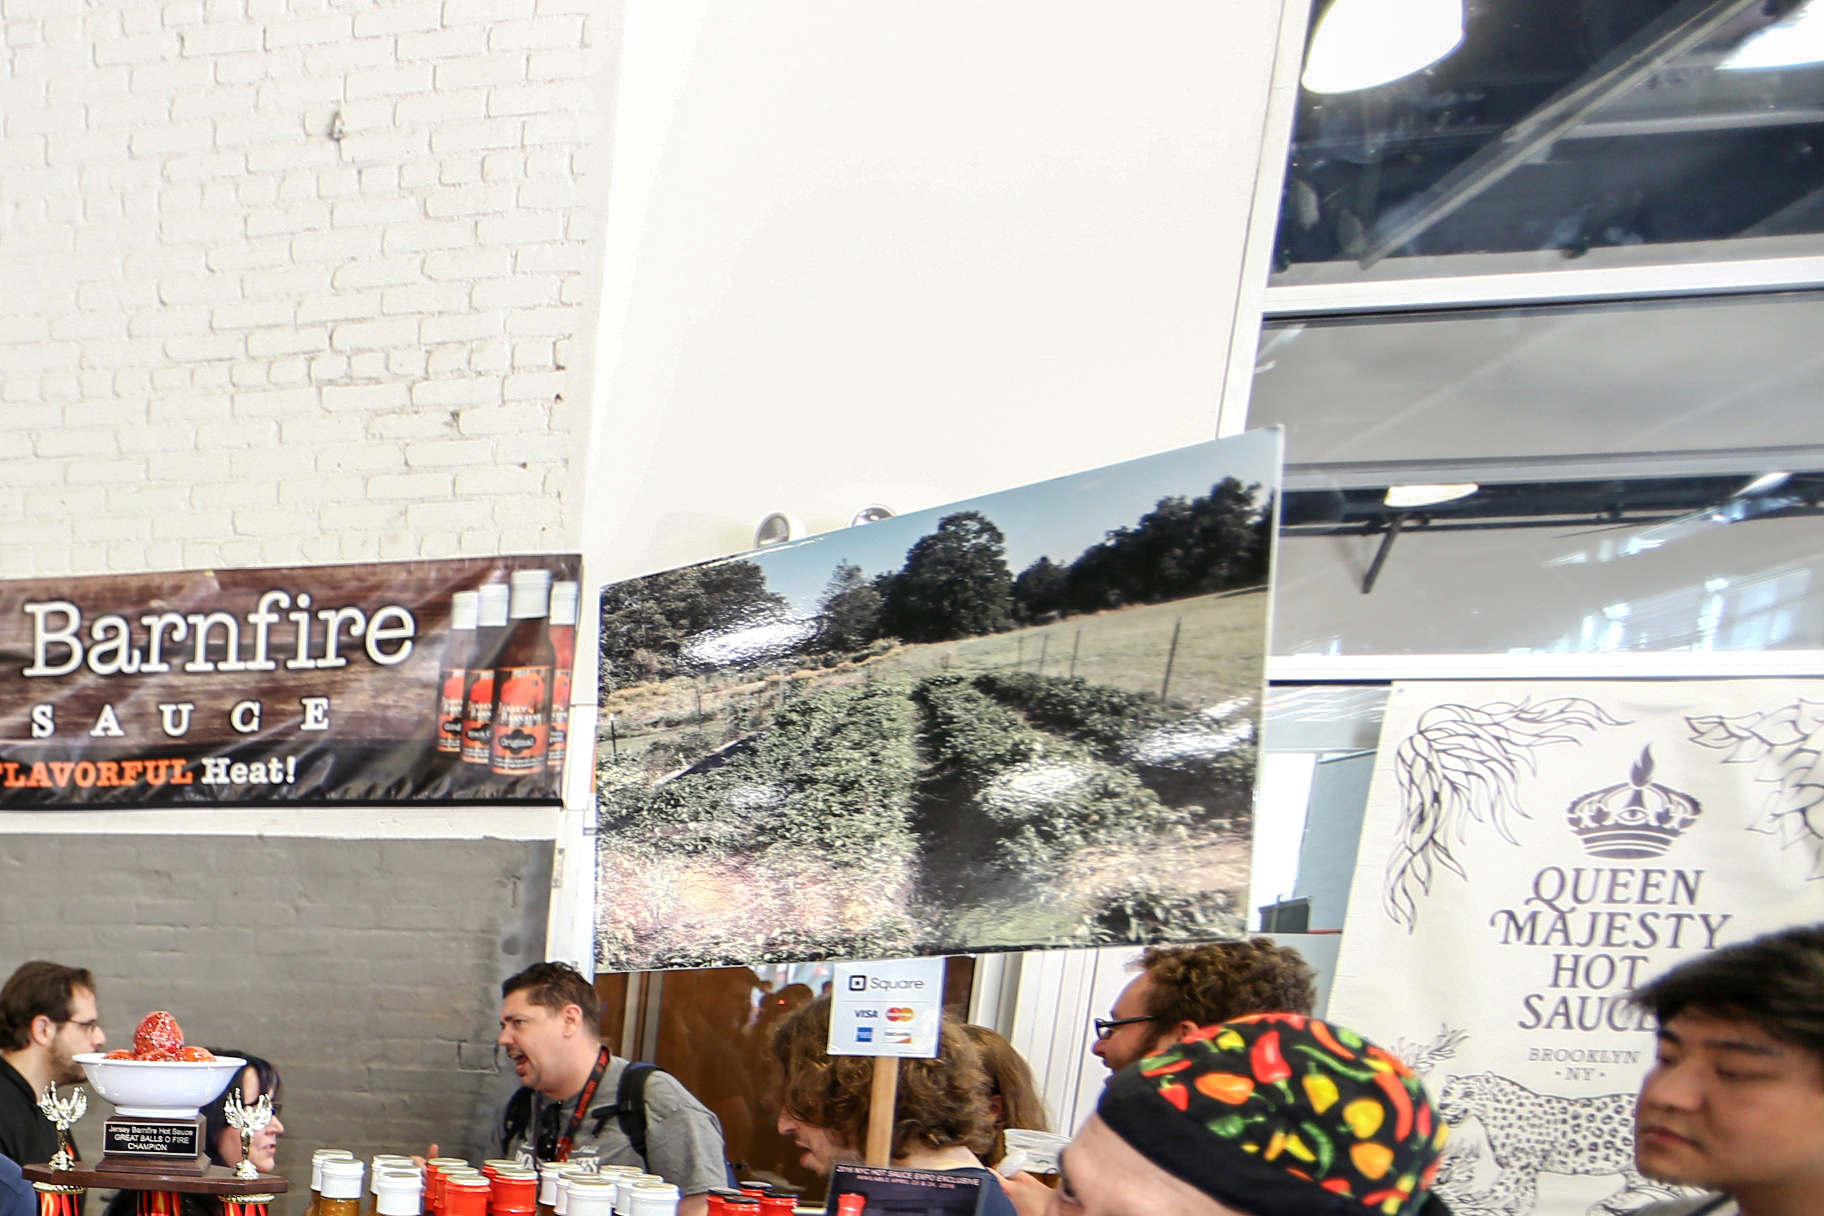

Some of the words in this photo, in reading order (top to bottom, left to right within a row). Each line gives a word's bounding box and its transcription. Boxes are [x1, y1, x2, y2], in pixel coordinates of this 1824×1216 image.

[22, 591, 416, 678] Barnfire
[31, 697, 331, 739] SAUCE
[200, 756, 297, 785] Heat!
[1524, 866, 1706, 912] QUEEN
[1490, 910, 1734, 951] MAJESTY
[1548, 953, 1649, 990] HOT
[870, 976, 925, 992] Square
[854, 1009, 879, 1019] VISA
[1528, 1047, 1641, 1064] BROOKLYN
[108, 1125, 130, 1134] Jersey
[132, 1126, 157, 1134] Barnfire
[159, 1127, 171, 1135] Hot
[172, 1128, 193, 1136] Sauce
[114, 1133, 139, 1141] GREAT
[172, 1136, 189, 1144] FIRE
[128, 1143, 168, 1151] CHAMPION
